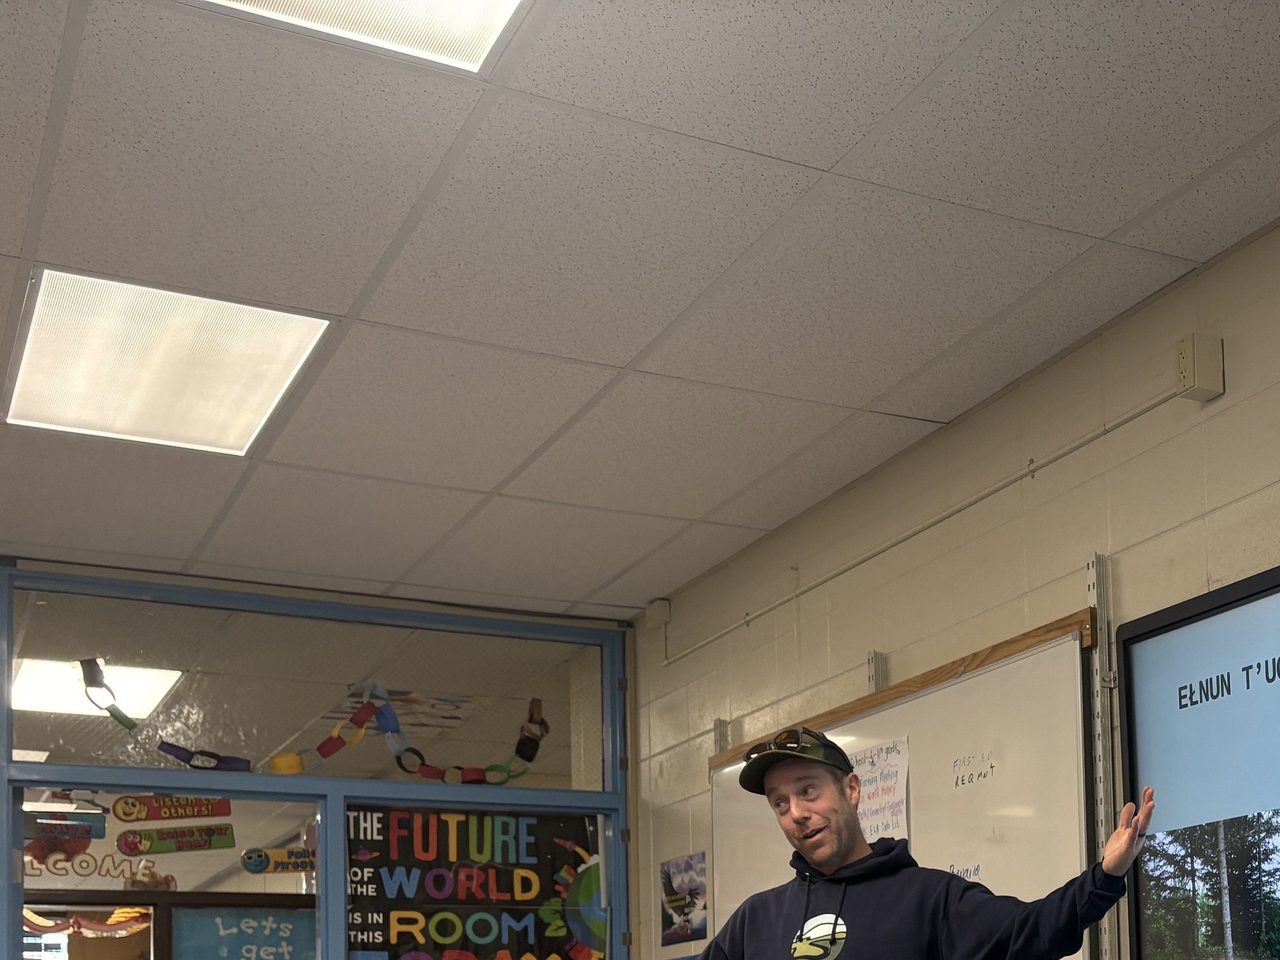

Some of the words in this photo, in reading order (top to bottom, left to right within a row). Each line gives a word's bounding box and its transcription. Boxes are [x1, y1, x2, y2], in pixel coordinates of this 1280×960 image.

[1178, 671, 1231, 710] EŁNUN
[347, 811, 384, 841] THE
[388, 811, 538, 864] FUTURE
[350, 867, 374, 882] OF
[379, 866, 541, 901] WORLD
[348, 884, 377, 896] THE
[214, 916, 293, 937] Lets
[349, 912, 362, 924] IS
[368, 912, 383, 924] IN
[389, 910, 535, 945] ROOM
[349, 931, 383, 943] THIS
